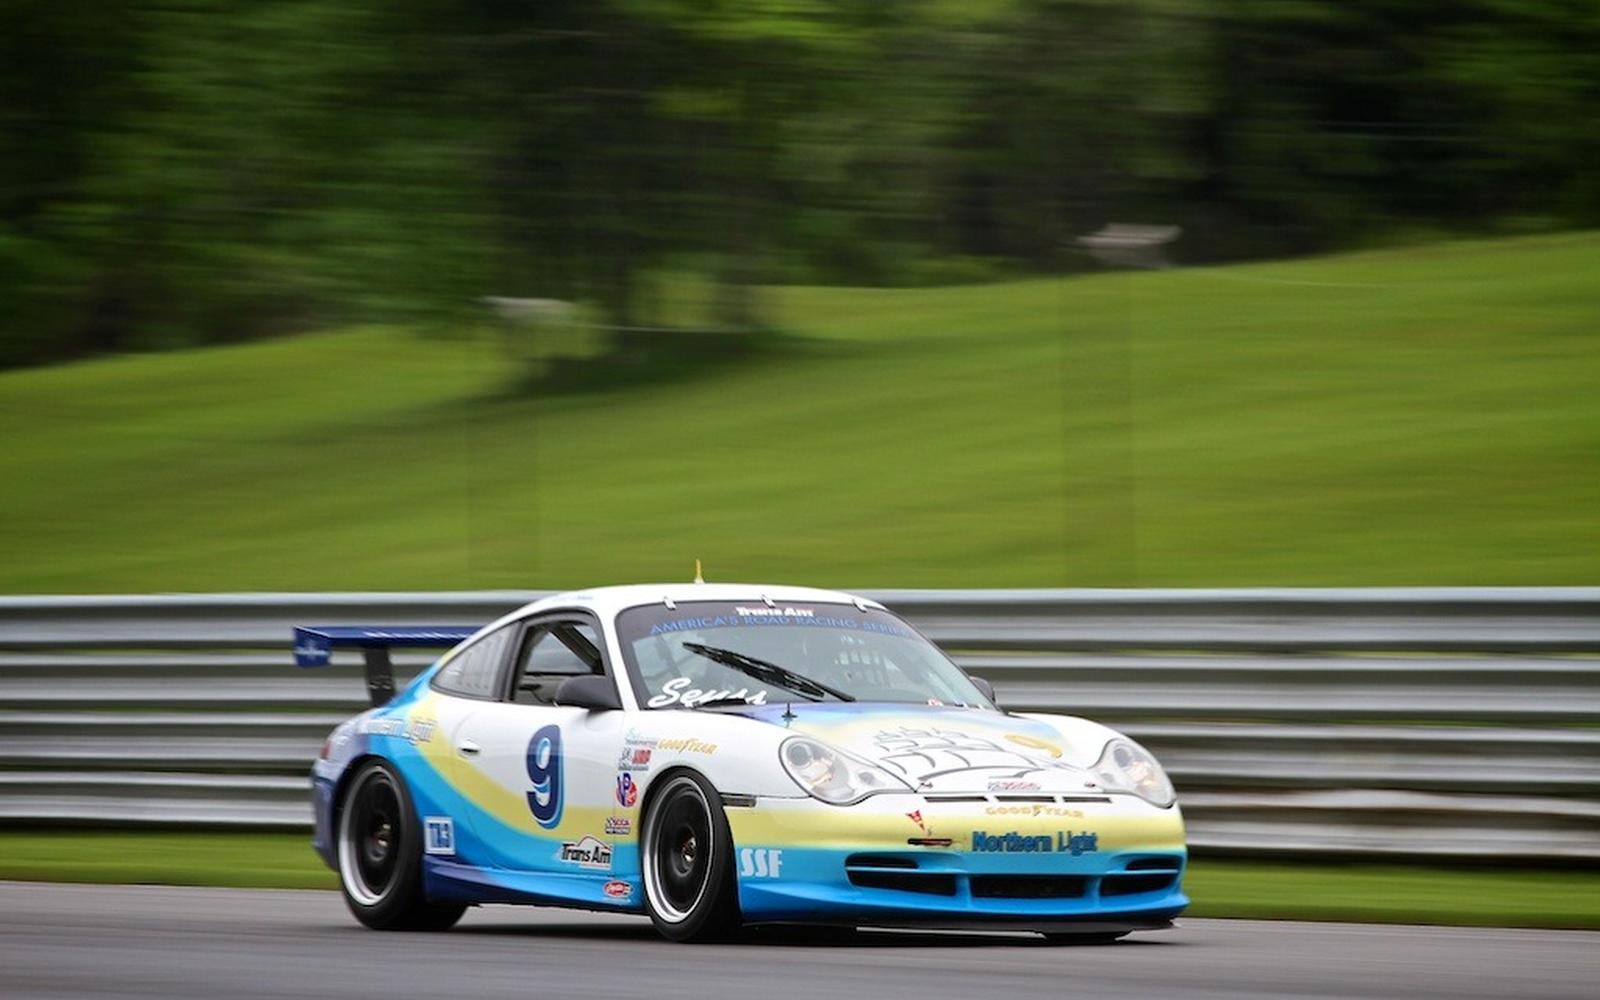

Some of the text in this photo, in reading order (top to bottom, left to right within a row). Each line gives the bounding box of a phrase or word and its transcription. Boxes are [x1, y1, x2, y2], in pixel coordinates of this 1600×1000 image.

[743, 614, 790, 626] ROAD
[796, 616, 857, 629] RACING
[526, 724, 564, 830] 9
[985, 804, 1084, 819] GOODYEAR
[561, 842, 611, 864] Trans Am
[972, 829, 1098, 857] Northern Light
[740, 848, 783, 878] SSF
